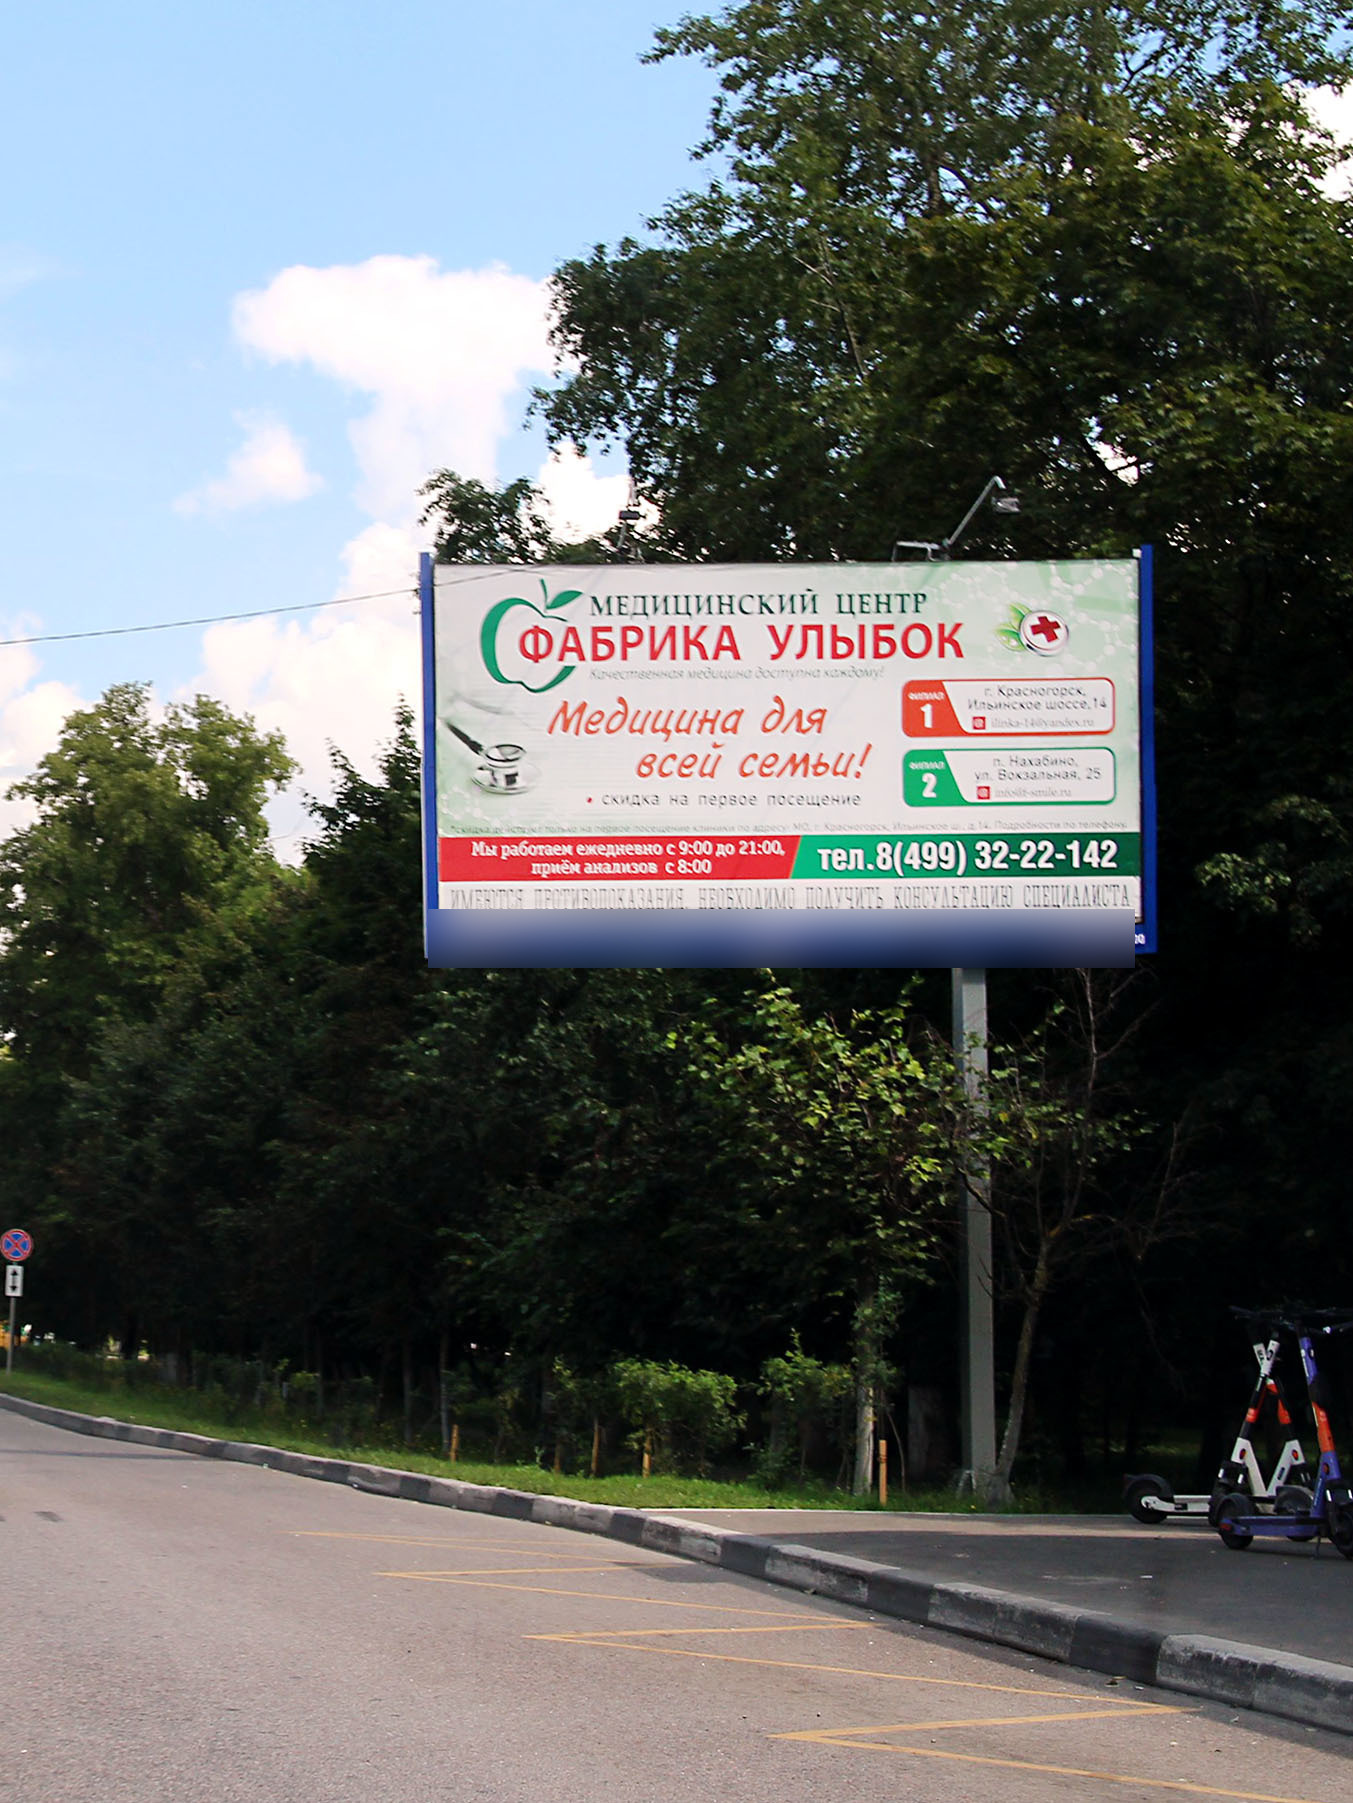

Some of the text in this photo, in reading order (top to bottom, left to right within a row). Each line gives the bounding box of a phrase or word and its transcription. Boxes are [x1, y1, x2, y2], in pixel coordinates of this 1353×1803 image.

[589, 589, 927, 619] МЕДИЦИНСКИЙ ЦЕНТР
[518, 622, 965, 663] ФАБРИКА УЛЫБОК
[547, 694, 828, 742] Медицина для
[920, 703, 933, 729] 1
[967, 699, 1041, 711] Ильинское
[635, 741, 873, 779] всей семьи!
[921, 772, 937, 799] 2
[1085, 768, 1102, 780] 25
[601, 791, 863, 809] скидка на первое посещение
[471, 839, 786, 860] Мы работаем ежедневно с 9:00 до 21:00,
[973, 839, 1118, 870] 32-22-142
[530, 858, 712, 879] приём анализов с 8:00
[697, 887, 797, 910] НЕОБХОДИМО
[805, 886, 884, 910] ПОЛУЧИТЬ
[893, 885, 1014, 909] КОНСУЛЬТАЦИЮ
[1023, 884, 1132, 909] СПЕЦИАЛИСТА
